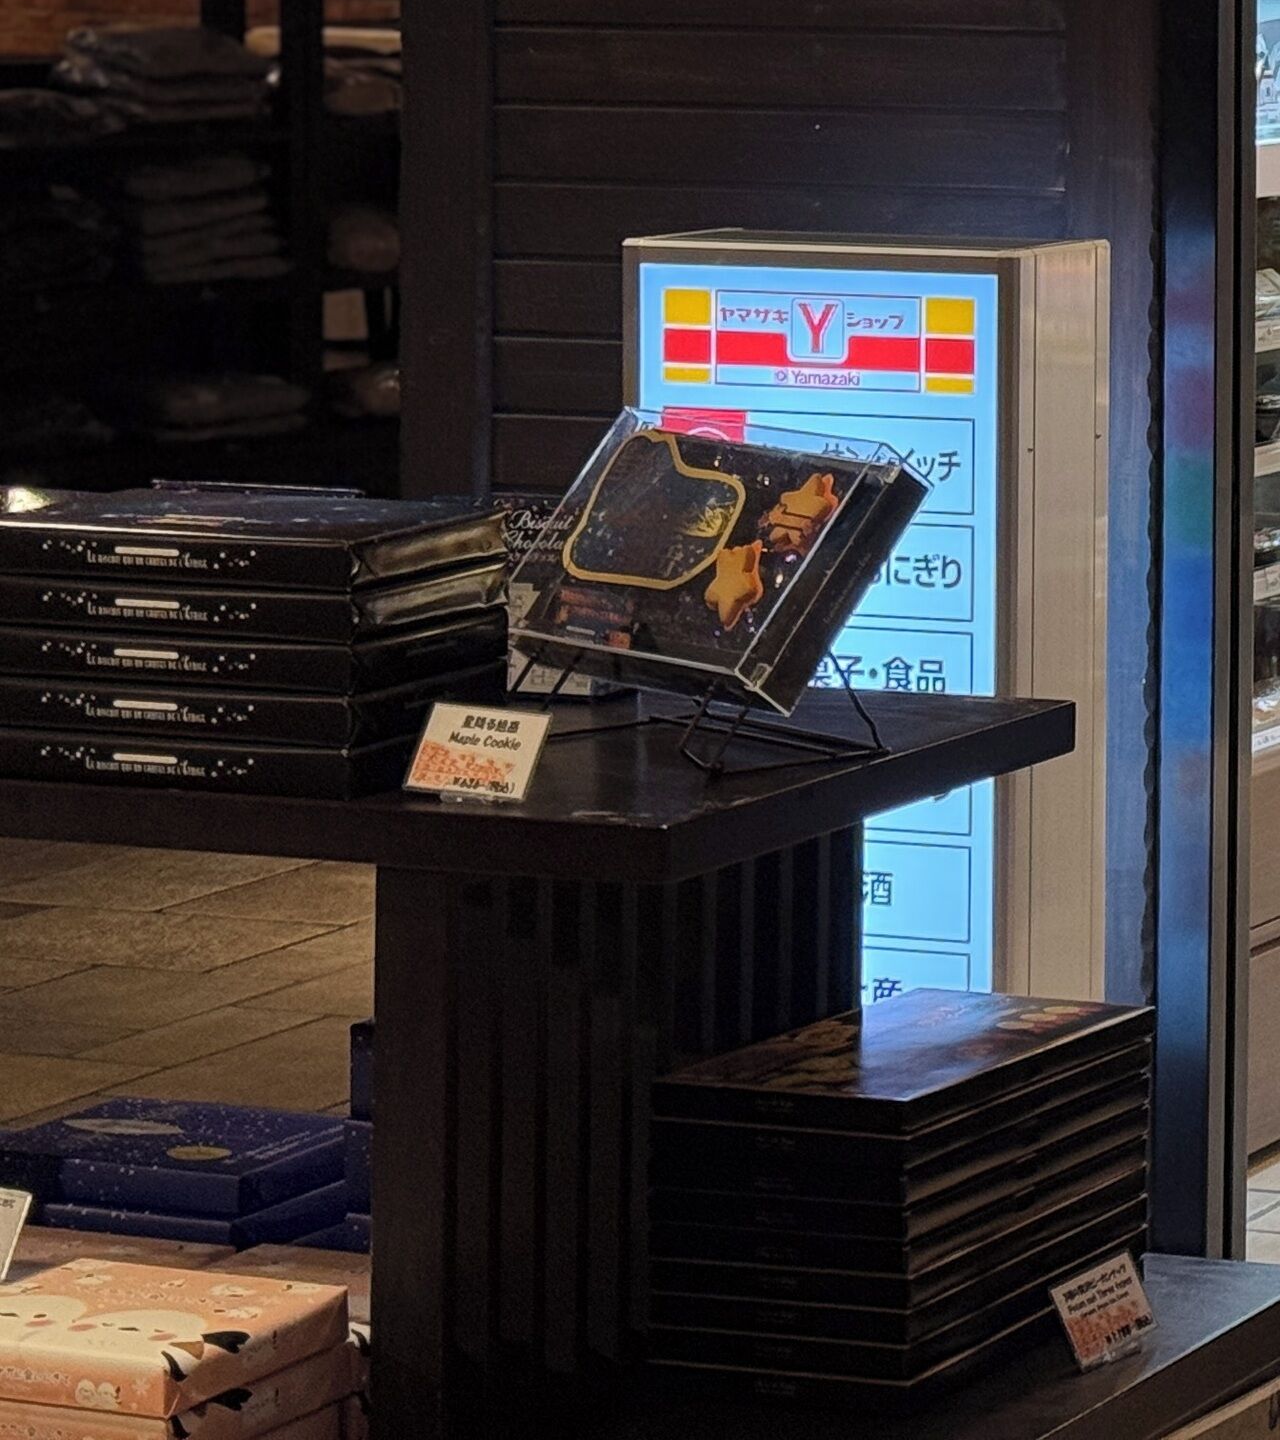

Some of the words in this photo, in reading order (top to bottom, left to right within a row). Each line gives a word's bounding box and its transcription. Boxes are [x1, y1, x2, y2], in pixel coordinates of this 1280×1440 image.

[798, 302, 839, 354] Y
[846, 312, 905, 330] ショップ
[791, 370, 861, 387] Yamazaki
[875, 553, 962, 589] にぎり
[448, 730, 481, 746] Maple
[483, 735, 522, 751] Cookie
